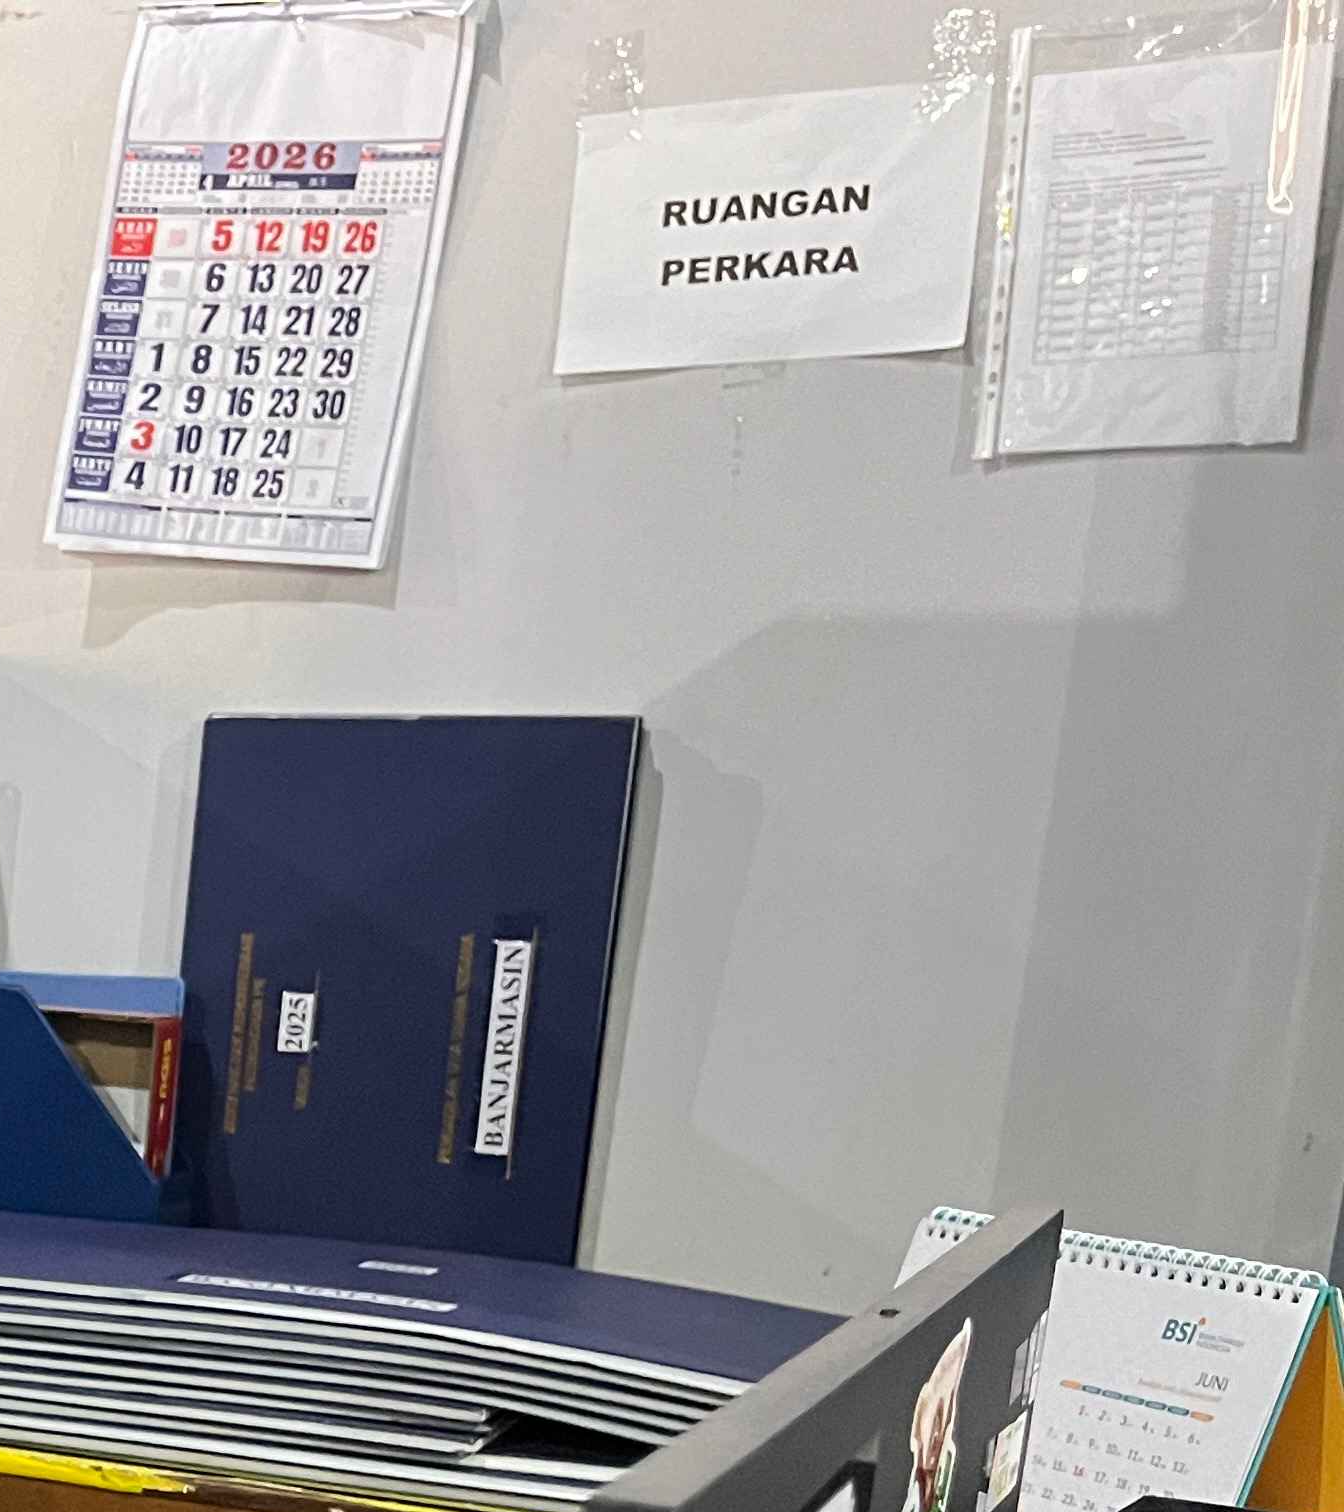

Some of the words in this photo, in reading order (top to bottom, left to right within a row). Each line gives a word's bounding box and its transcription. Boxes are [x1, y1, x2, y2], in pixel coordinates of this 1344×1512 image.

[226, 142, 337, 171] 2026
[226, 173, 273, 189] APRIL
[661, 184, 871, 228] RUANGAN
[212, 219, 234, 253] 5
[256, 220, 284, 254] 12
[303, 219, 331, 252] 19
[345, 222, 377, 254] 26
[206, 263, 227, 293] 6
[249, 263, 276, 293] 13
[290, 263, 323, 294] 20
[336, 264, 370, 295] 27
[661, 244, 860, 287] PERKARA
[200, 303, 220, 334] 7
[241, 305, 268, 335] 14
[282, 305, 315, 336] 21
[328, 306, 361, 337] 28
[150, 343, 164, 373] 1
[191, 344, 213, 374] 8
[235, 345, 262, 376] 15
[275, 346, 307, 377] 22
[320, 348, 354, 379] 29
[138, 383, 162, 412] 2
[184, 385, 206, 414] 9
[228, 386, 255, 417] 16
[267, 388, 300, 418] 23
[312, 389, 346, 420] 30
[132, 421, 156, 451] 3
[175, 424, 203, 454] 10
[221, 427, 248, 457] 17
[260, 428, 292, 459] 24
[124, 461, 146, 490] 4
[170, 464, 194, 493] 11
[213, 467, 239, 496] 18
[252, 468, 285, 499] 25
[284, 996, 309, 1050] 2025
[483, 943, 526, 1149] BANJARMASIN
[1161, 1319, 1198, 1345] BSI
[1195, 1372, 1229, 1392] JUNI
